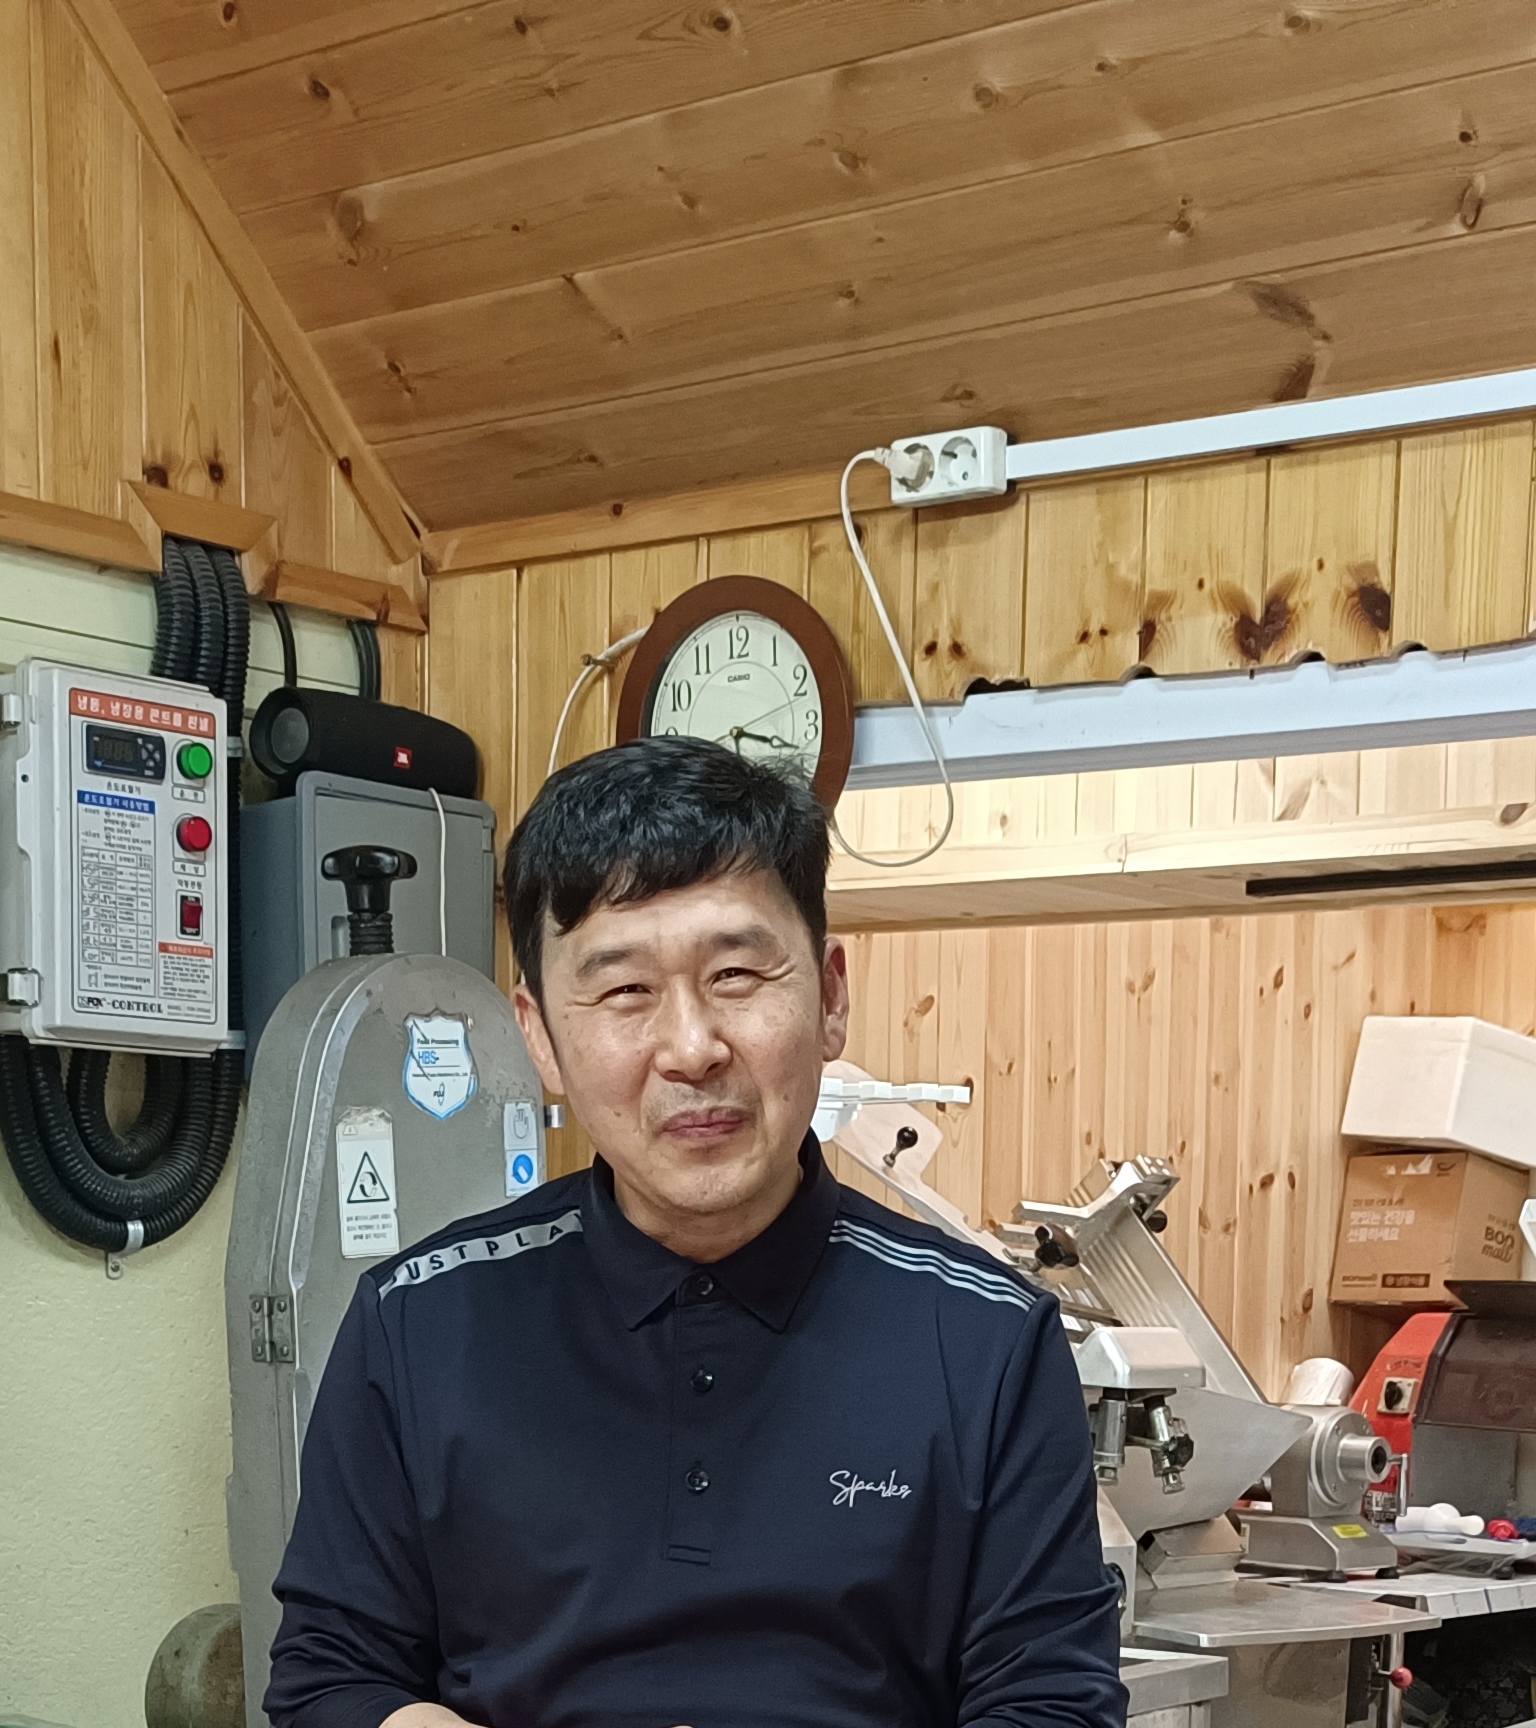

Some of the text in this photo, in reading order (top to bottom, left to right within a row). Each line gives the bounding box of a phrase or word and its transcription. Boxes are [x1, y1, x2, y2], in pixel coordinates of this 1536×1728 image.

[694, 642, 712, 676] 11
[728, 625, 750, 660] 12
[771, 634, 779, 667] 1
[671, 678, 692, 712] 10
[793, 663, 808, 697] 2
[804, 709, 819, 742] 3
